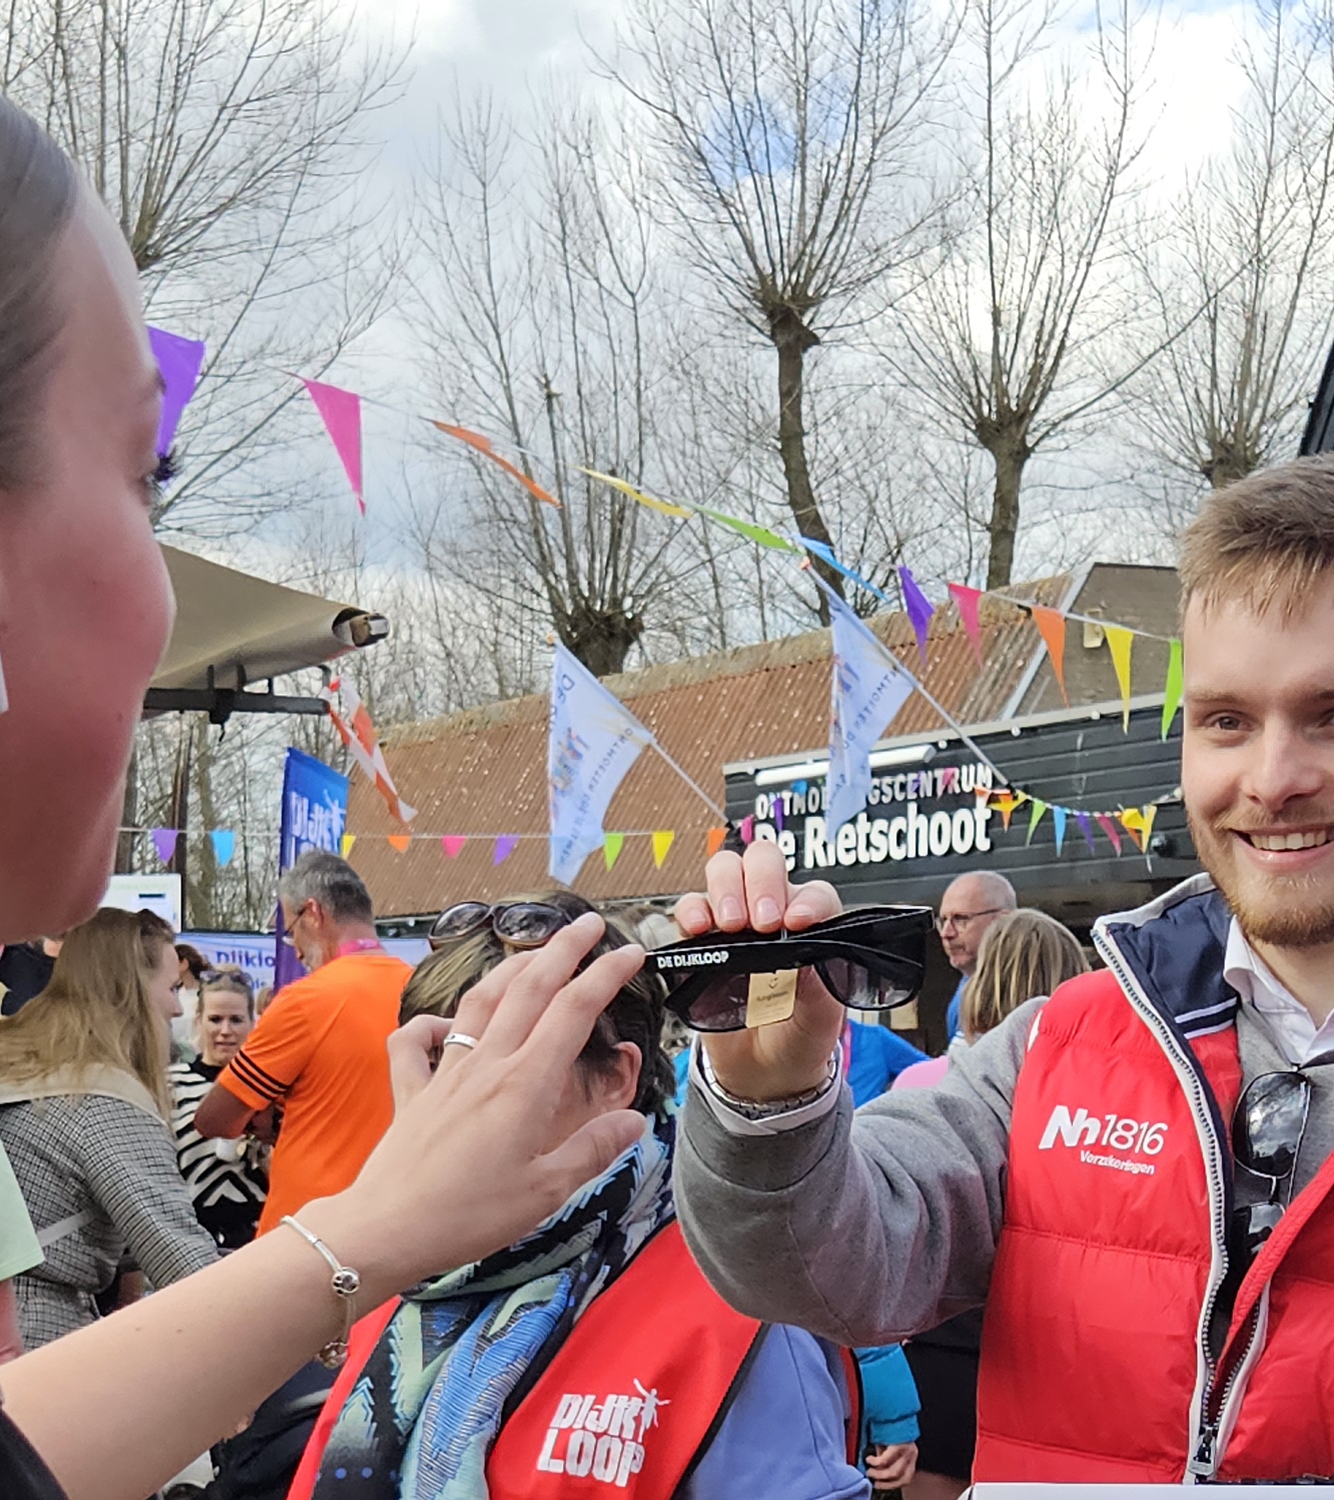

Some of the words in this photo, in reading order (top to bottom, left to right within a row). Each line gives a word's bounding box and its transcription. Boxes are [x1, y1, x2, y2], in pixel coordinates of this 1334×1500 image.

[657, 955, 672, 969] DE
[673, 950, 730, 968] DIJKLOOP
[537, 1429, 646, 1488] LOOP
